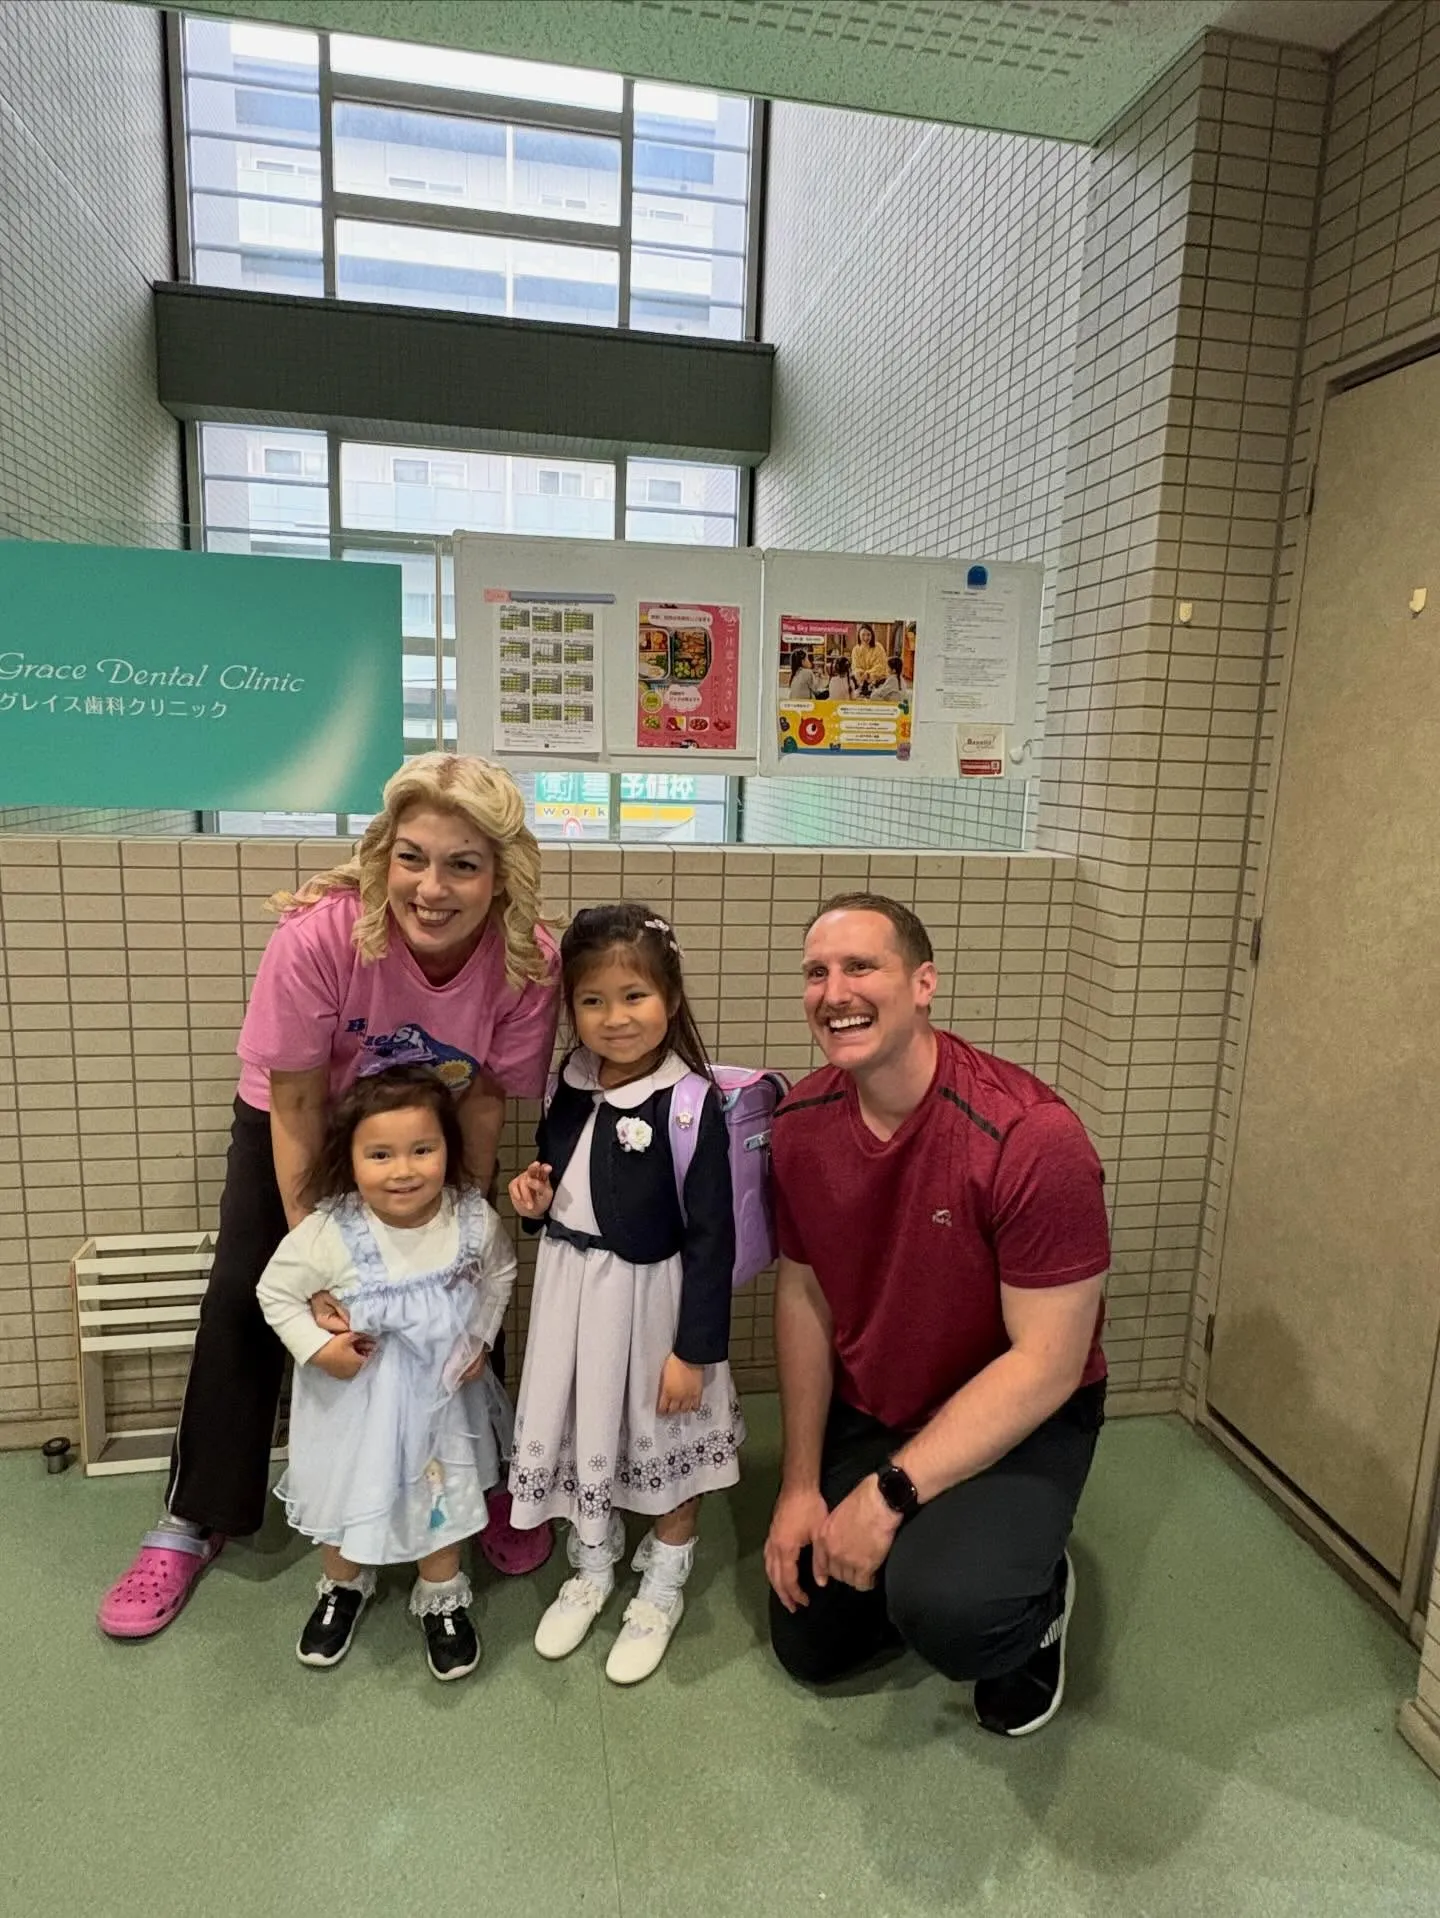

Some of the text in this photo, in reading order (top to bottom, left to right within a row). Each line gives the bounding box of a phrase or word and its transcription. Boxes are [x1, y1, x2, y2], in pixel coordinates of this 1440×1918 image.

[0, 652, 306, 692] Grace Dental Clinic
[0, 692, 228, 719] グレイス歯科クリニック
